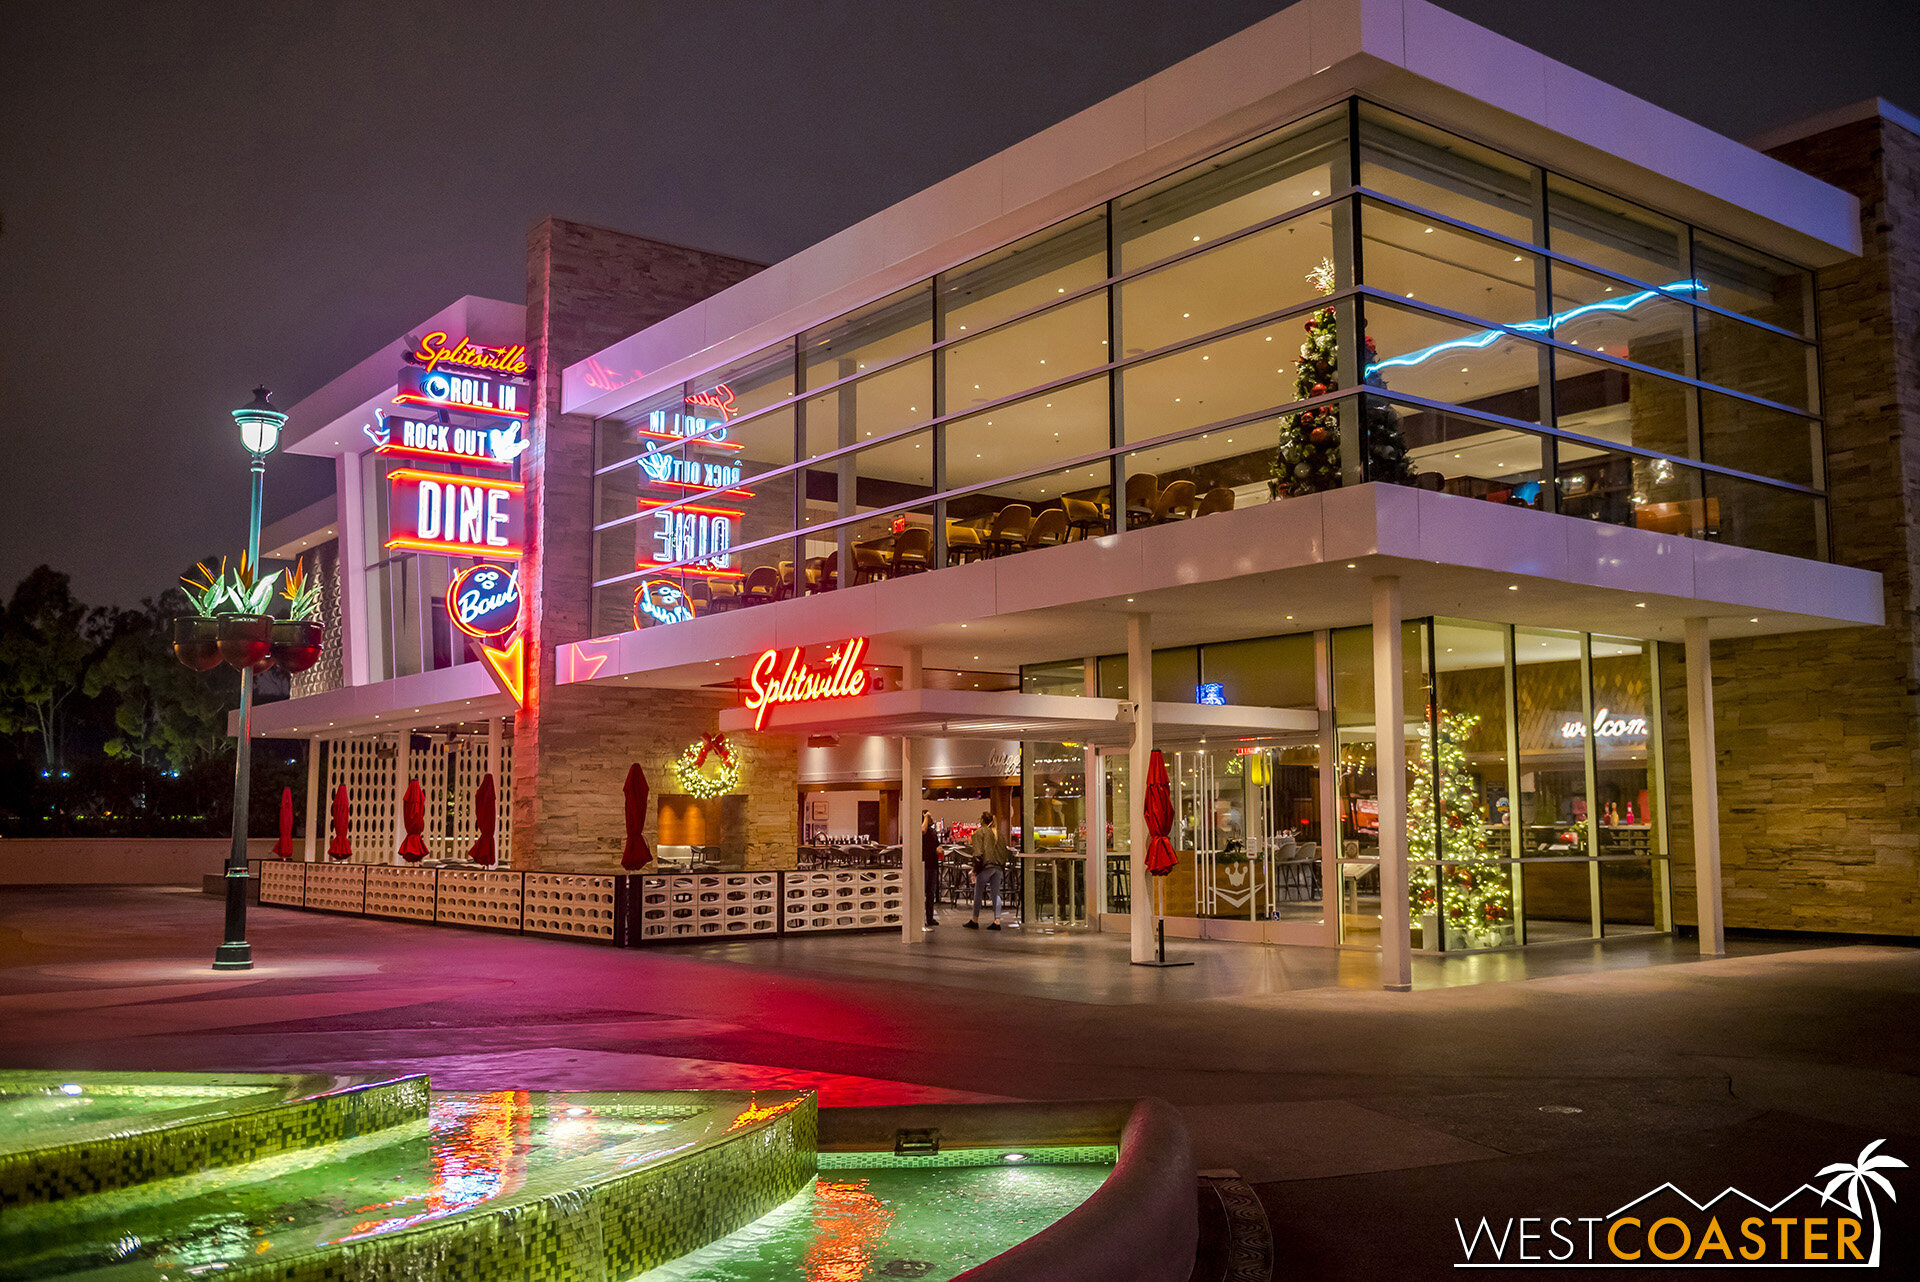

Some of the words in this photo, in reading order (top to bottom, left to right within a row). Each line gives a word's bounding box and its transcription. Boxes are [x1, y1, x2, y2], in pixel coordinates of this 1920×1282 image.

[415, 331, 529, 374] Splitsville
[450, 376, 494, 408] ROLL
[498, 384, 517, 412] IN
[403, 420, 449, 452] ROCK
[453, 427, 488, 457] OUT
[417, 480, 511, 547] DINE
[457, 568, 519, 624] Bowl
[744, 636, 867, 732] Splitsville
